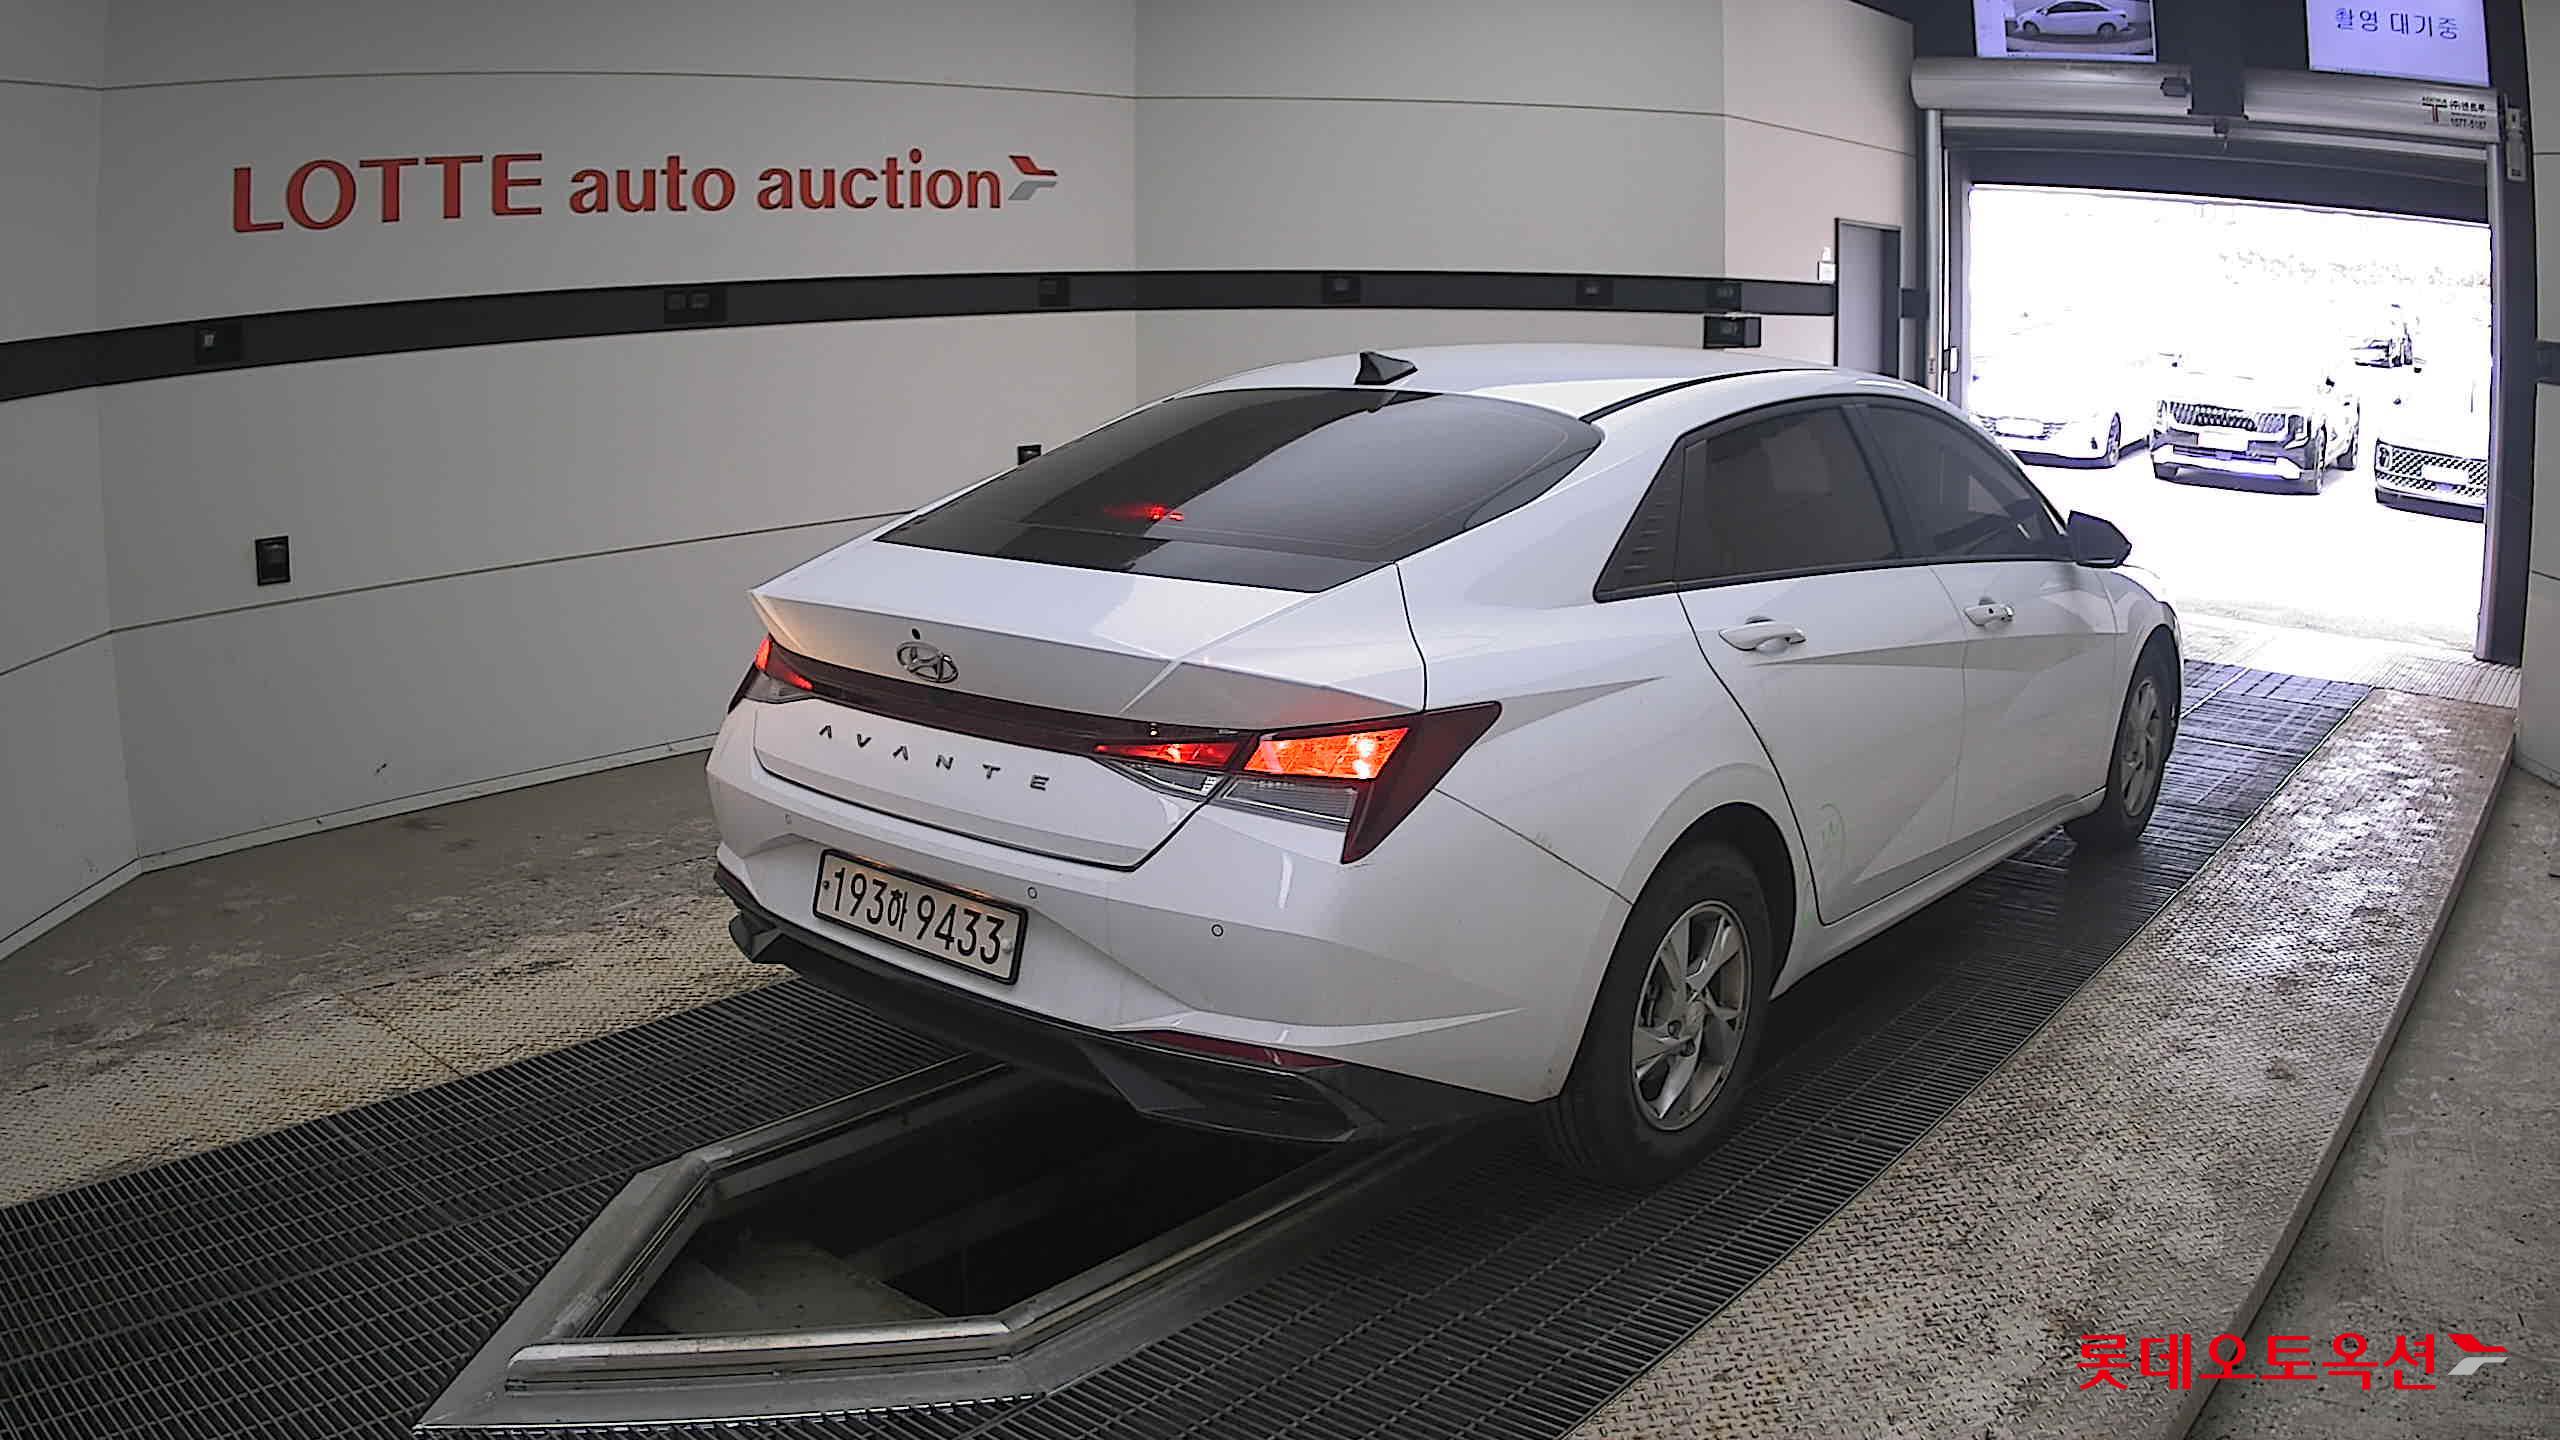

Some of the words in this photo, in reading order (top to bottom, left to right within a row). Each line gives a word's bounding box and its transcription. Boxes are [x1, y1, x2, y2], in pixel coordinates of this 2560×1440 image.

[2336, 8, 2378, 33] 촬영
[2390, 13, 2457, 40] 대기중
[234, 153, 543, 233] LOTTE
[569, 155, 737, 214] auto
[757, 148, 1001, 211] auction
[819, 725, 1050, 791] AVANTE
[916, 894, 1005, 965] 9433
